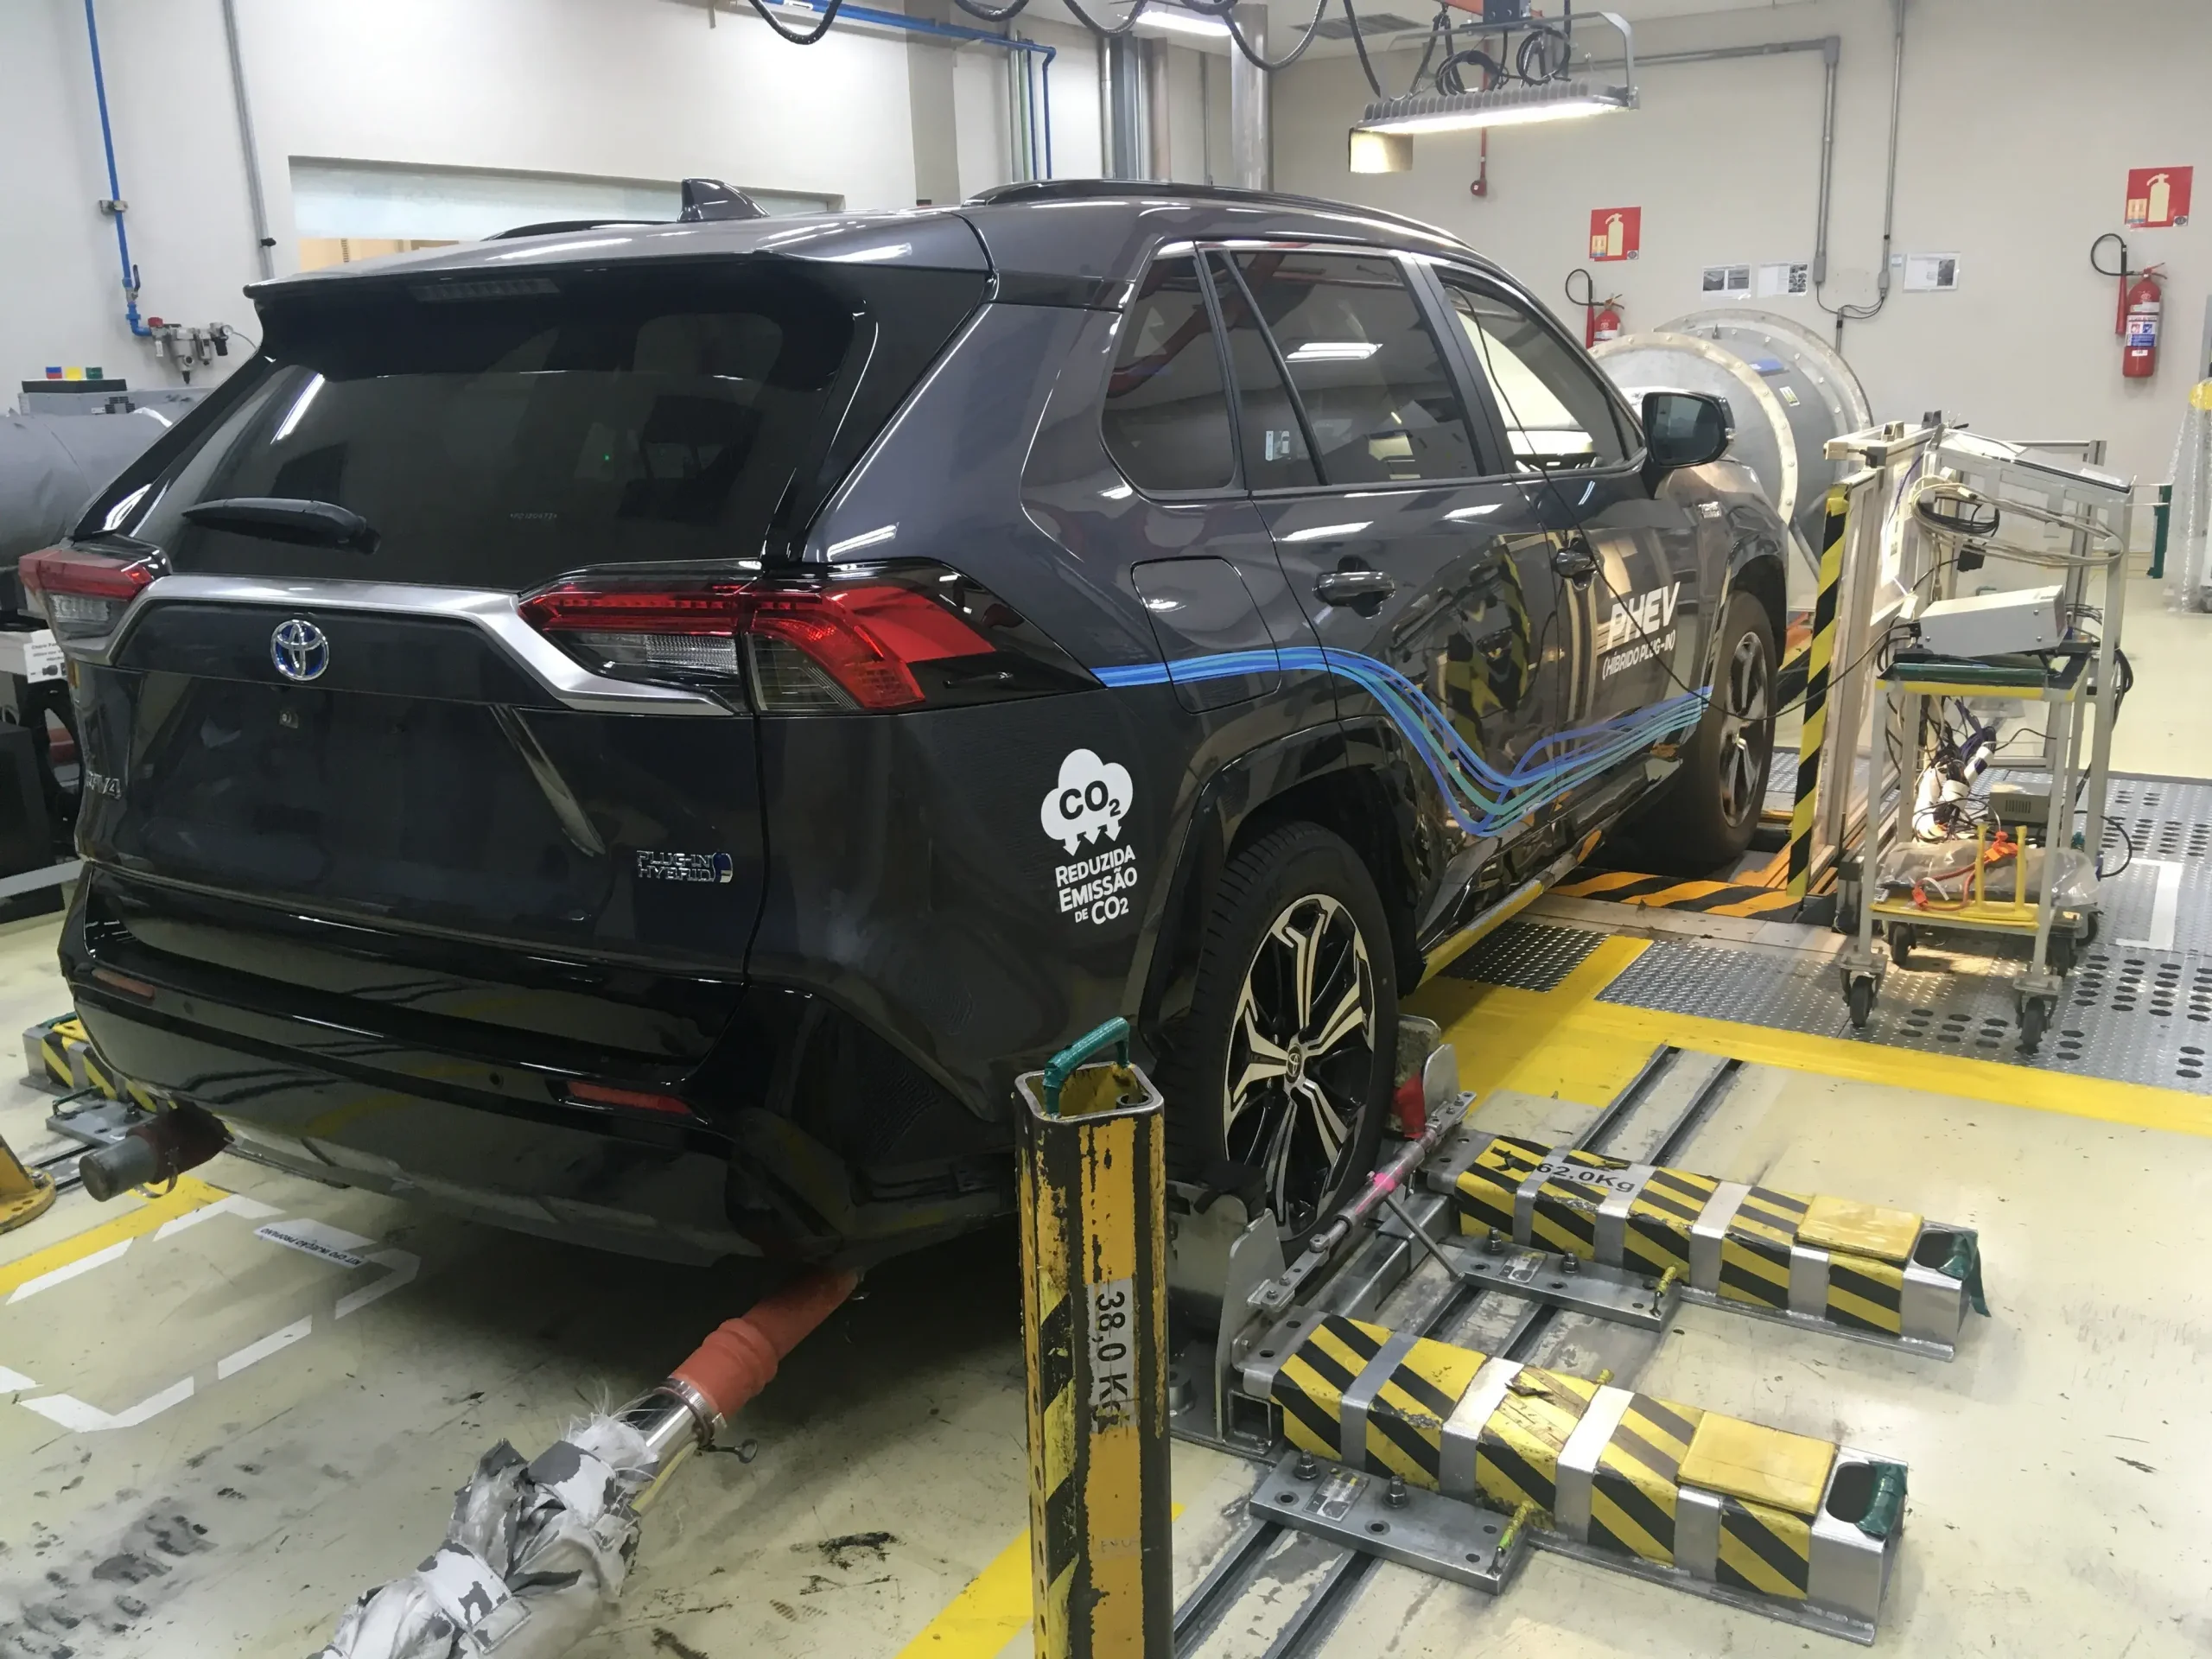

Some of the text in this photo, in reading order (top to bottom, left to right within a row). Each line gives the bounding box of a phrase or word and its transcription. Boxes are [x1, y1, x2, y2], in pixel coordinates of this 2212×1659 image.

[1605, 582, 1681, 651] PHEV
[1602, 645, 1639, 681] (HÍBRIDO
[1059, 780, 1121, 820] CO2
[637, 850, 714, 868] PLUG-IN
[638, 865, 715, 881] HYBRID
[1055, 844, 1136, 887] REDUZIDA
[1058, 867, 1138, 912] EMISSÃO
[1074, 896, 1129, 925] DE CO2
